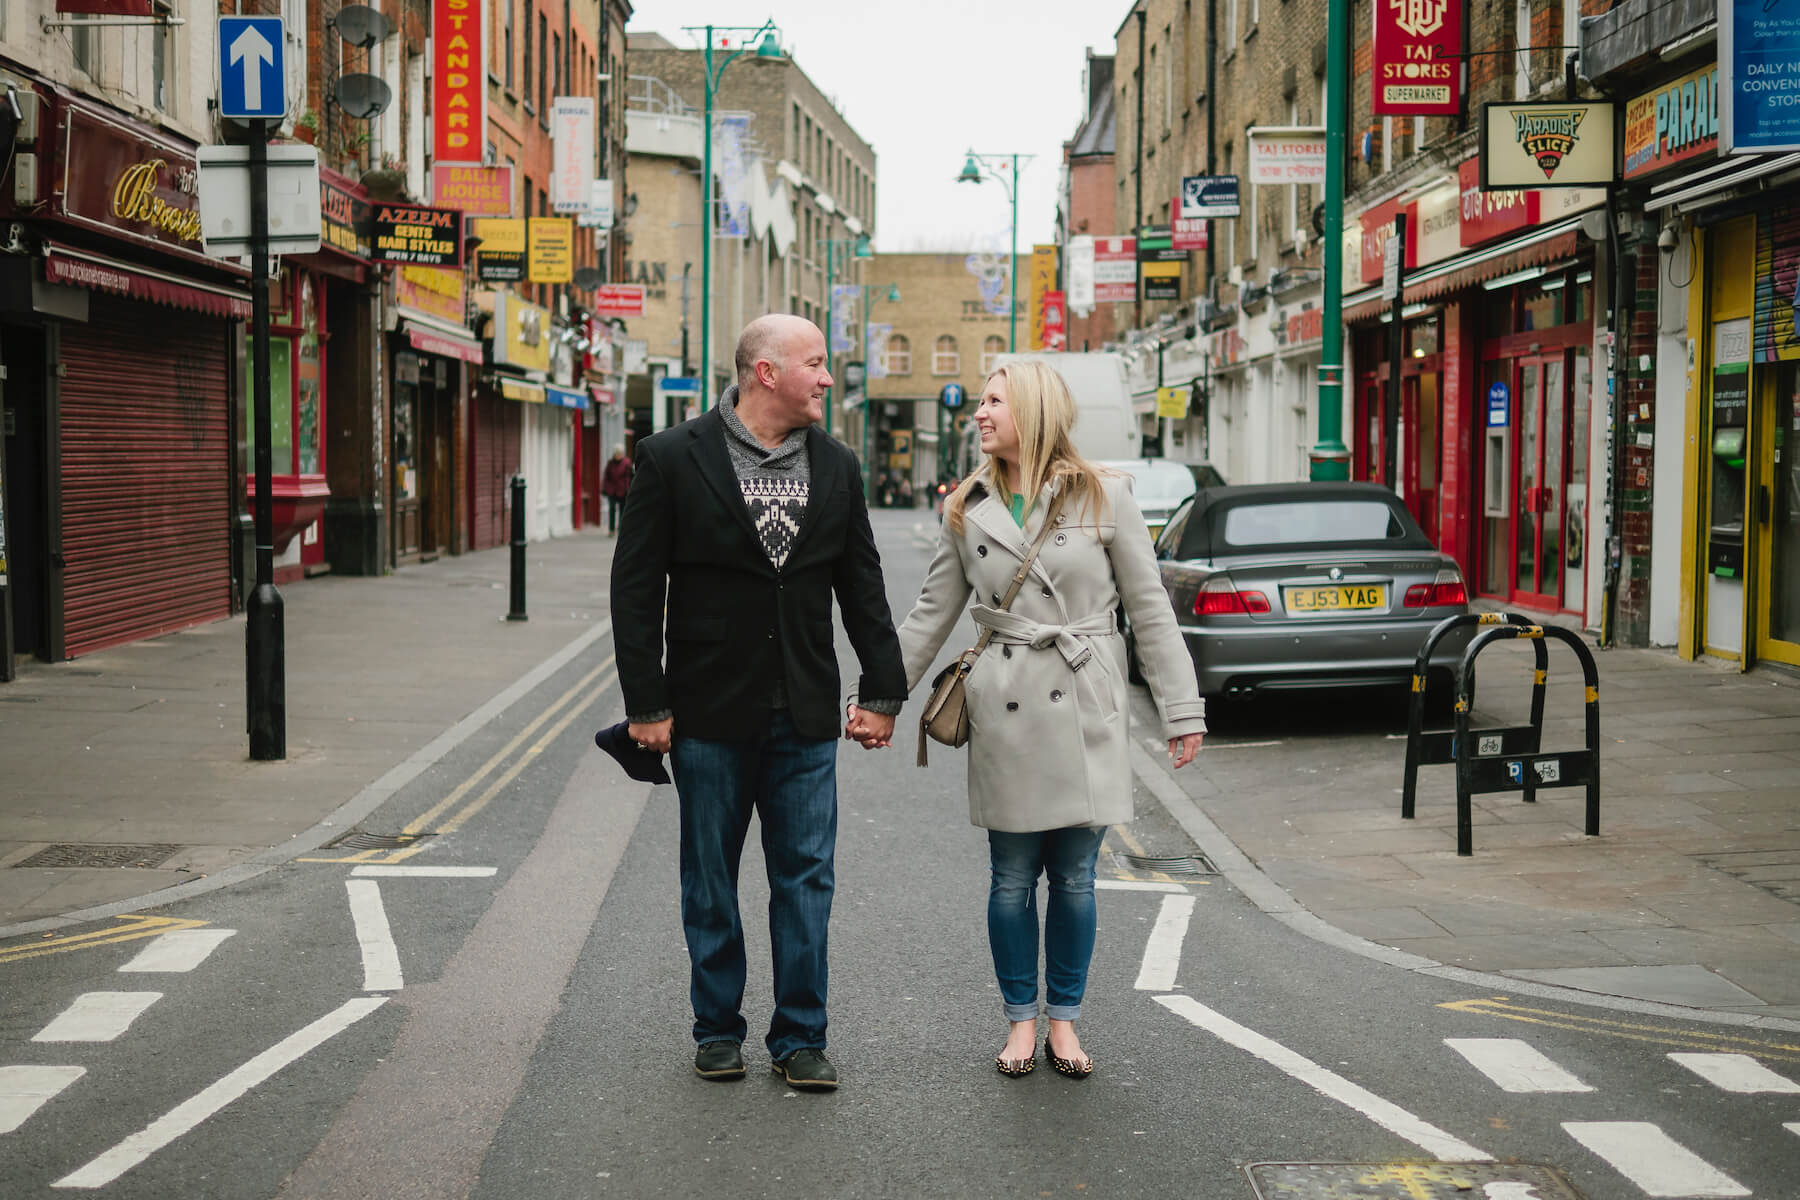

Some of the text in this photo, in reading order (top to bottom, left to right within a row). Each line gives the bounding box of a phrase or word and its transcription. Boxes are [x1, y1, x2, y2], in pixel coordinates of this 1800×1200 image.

[1403, 45, 1433, 61] TAJ
[447, 0, 469, 148] STANDARD
[1384, 63, 1451, 78] STORES
[1747, 63, 1784, 75] DAILY
[1387, 88, 1446, 101] SUPERMARKET
[1515, 111, 1580, 143] PARADISE
[1257, 144, 1326, 155] TAJ STORES
[1527, 138, 1570, 154] SLICE
[449, 167, 496, 184] BALTI
[442, 184, 504, 200] HOUSE
[377, 208, 453, 228] AZEEM
[395, 224, 432, 239] GENTS
[378, 235, 454, 254] HAIR STYLES
[409, 252, 416, 261] 7
[1295, 589, 1377, 607] EJ53 YAG
